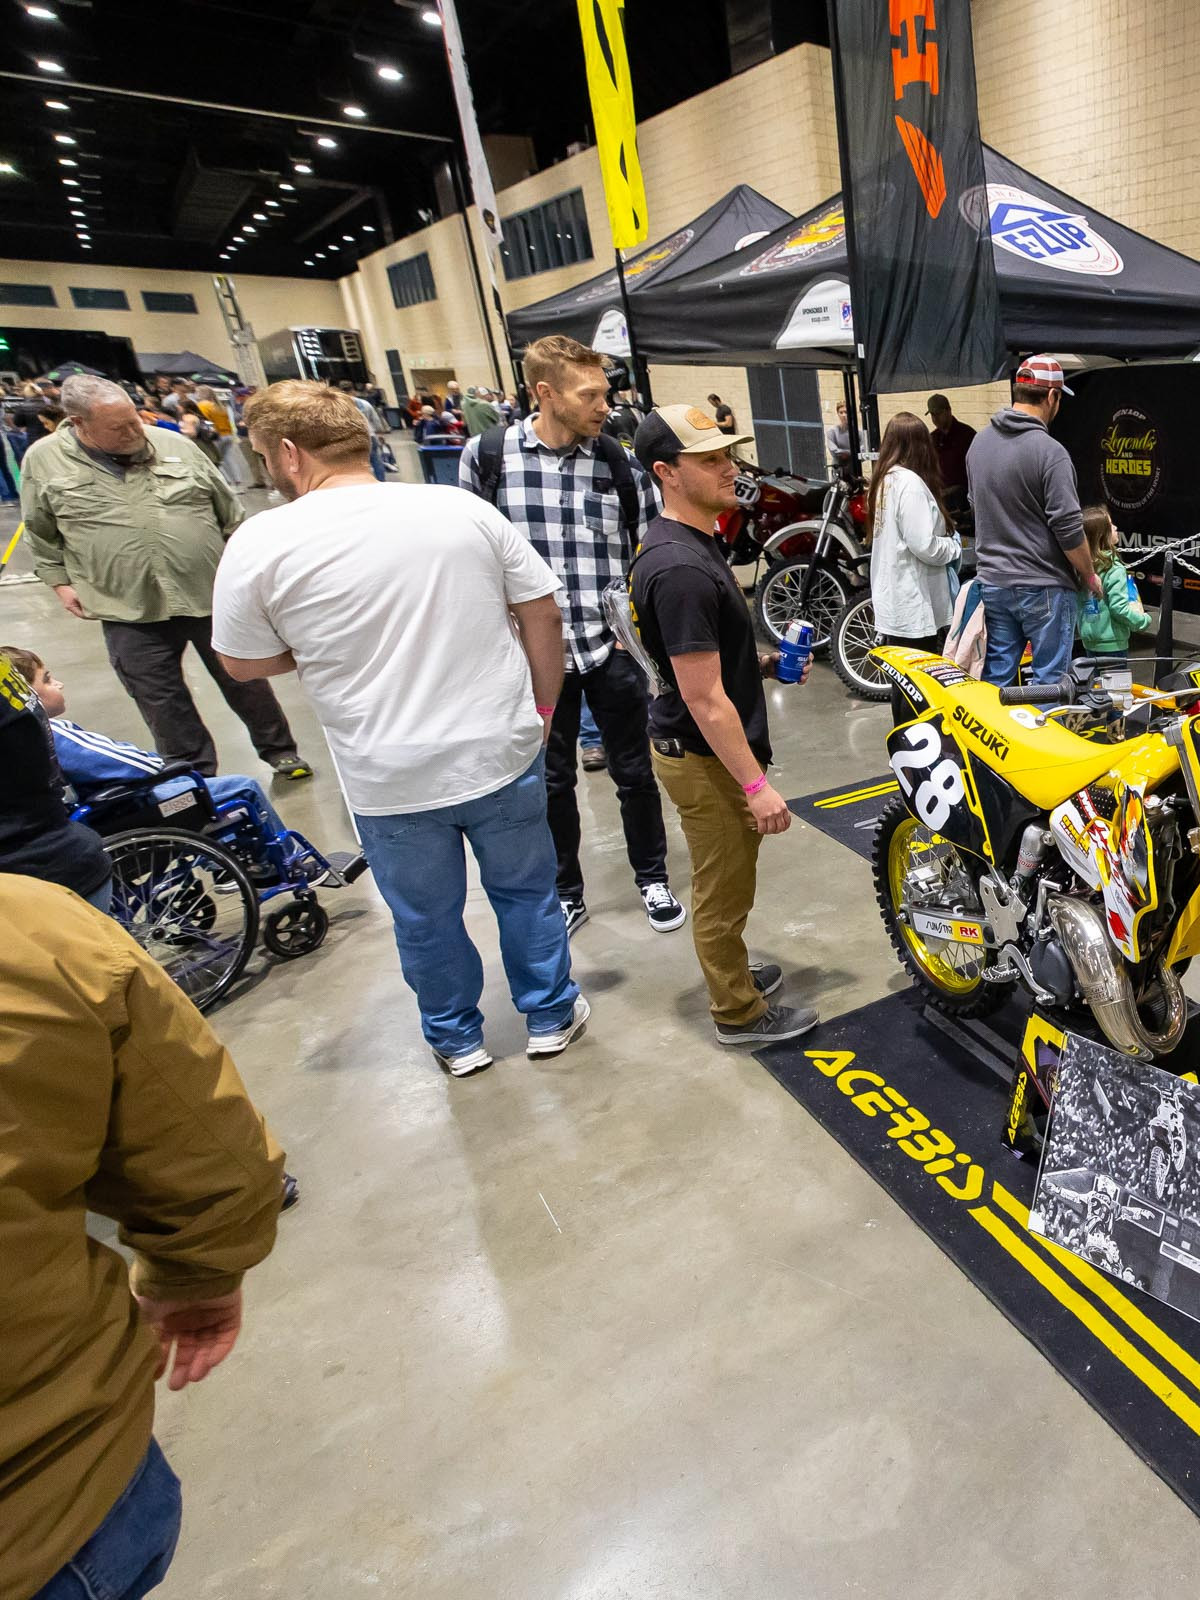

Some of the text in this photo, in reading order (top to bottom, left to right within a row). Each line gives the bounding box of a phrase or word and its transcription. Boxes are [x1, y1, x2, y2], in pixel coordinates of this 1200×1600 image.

[1101, 424, 1157, 457] Legends
[1106, 459, 1152, 475] HEROES
[881, 661, 924, 703] DUNLOP
[952, 705, 1010, 761] SUZUKI
[891, 722, 965, 831] 28
[959, 926, 979, 937] RK
